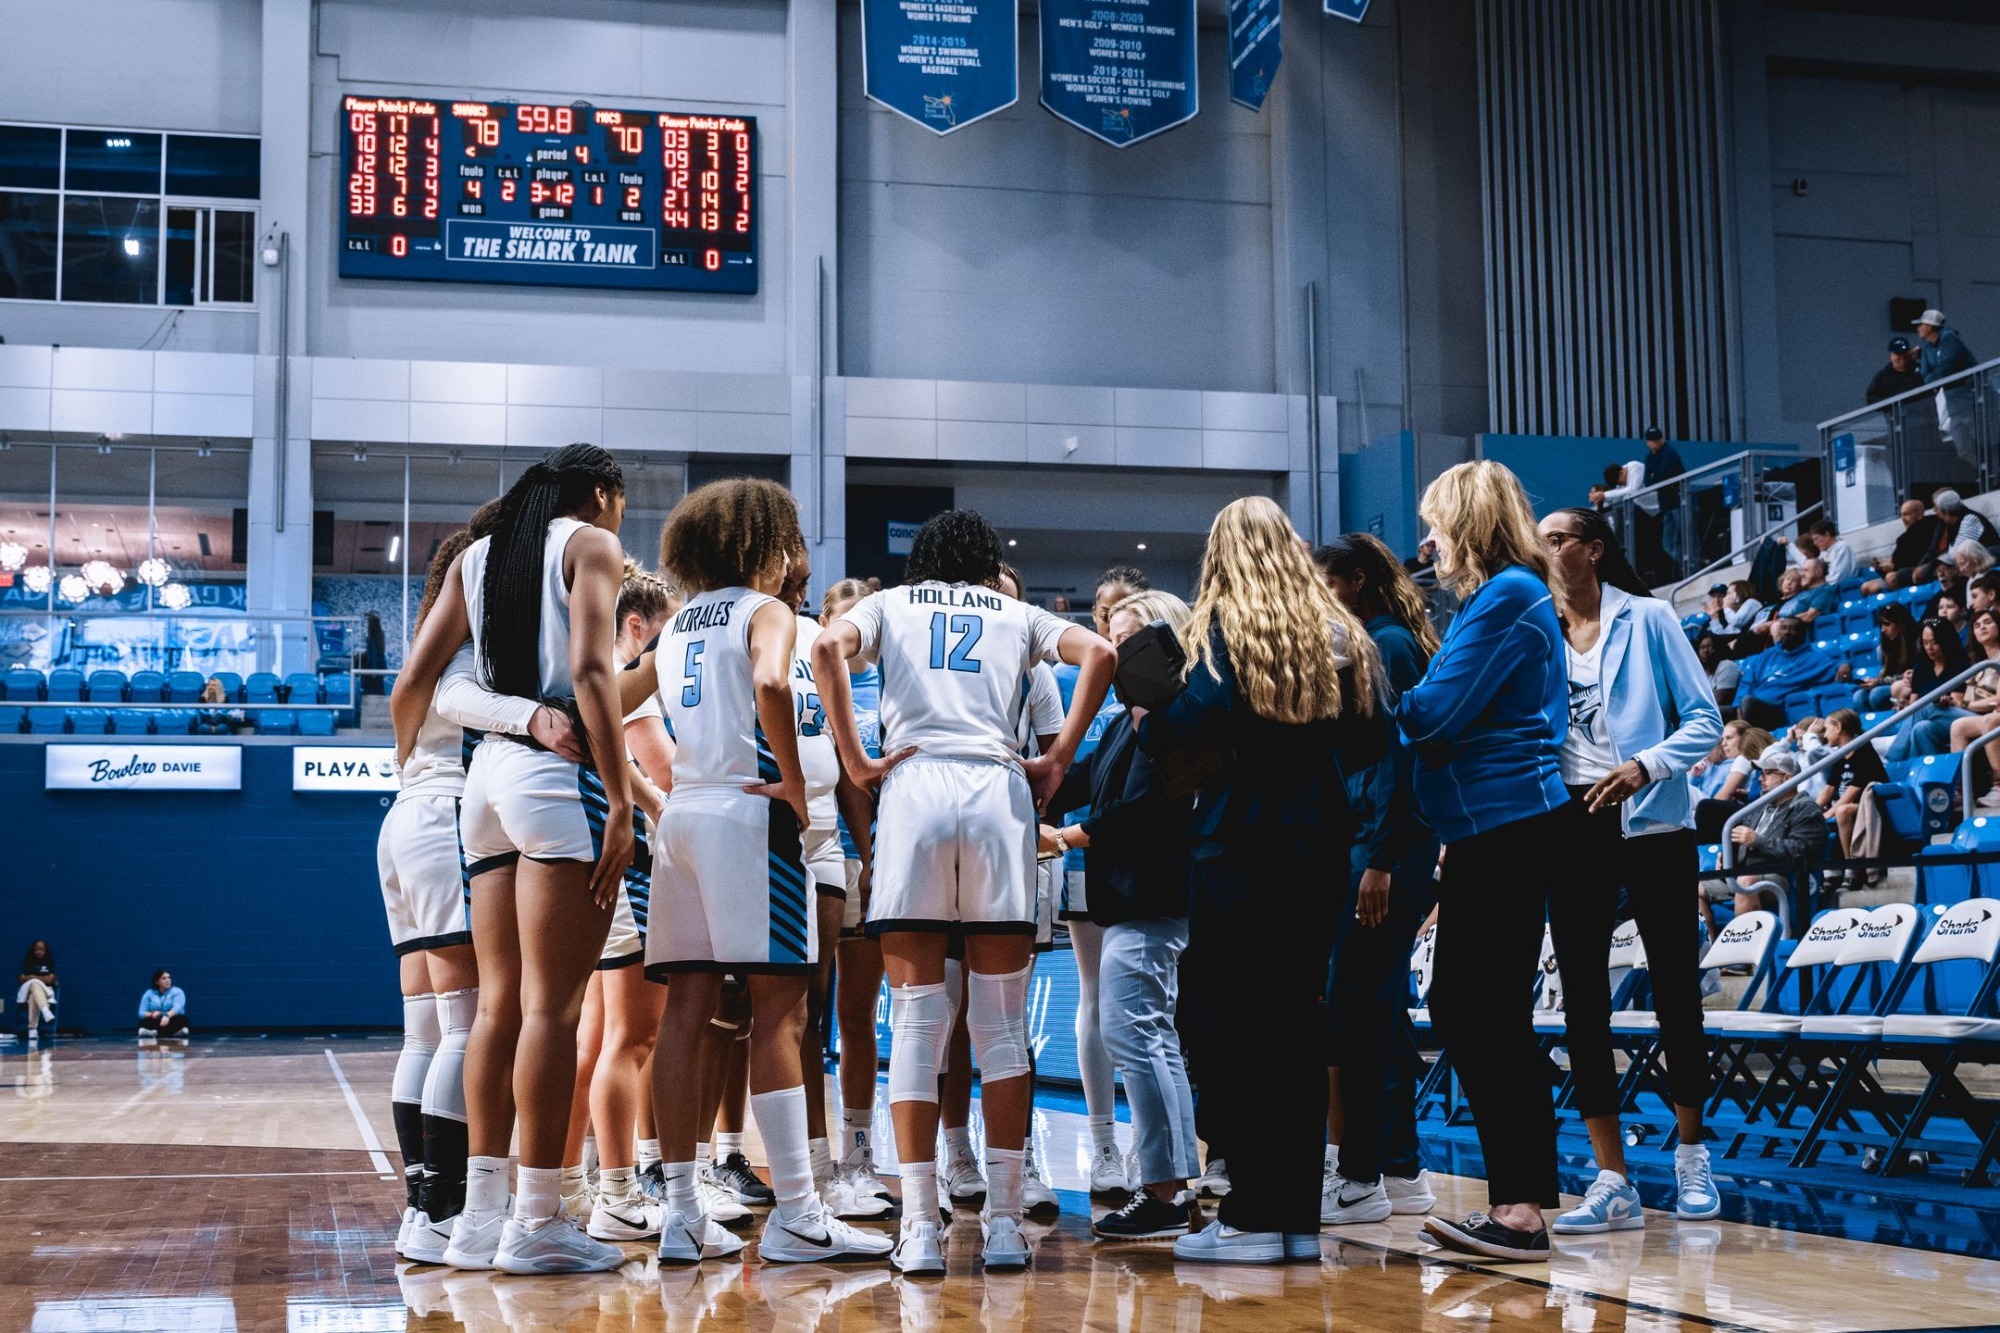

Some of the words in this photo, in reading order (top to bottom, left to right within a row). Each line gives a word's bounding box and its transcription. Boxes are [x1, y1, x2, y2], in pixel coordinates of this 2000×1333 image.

[900, 2, 933, 12] WOMEN'S
[935, 5, 978, 14] BASKETBALL
[1092, 10, 1144, 23] 2008-2009
[906, 12, 940, 22] WOMEN'S
[942, 14, 972, 23] ROWING
[1060, 18, 1082, 28] MEN'S
[1084, 20, 1102, 30] GOLF
[1111, 23, 1144, 33] WOMEN'S
[1146, 26, 1175, 36] ROWING
[912, 35, 966, 47] 2014-2015
[1094, 38, 1142, 50] 2009-2010
[900, 46, 936, 56] WOMEN'S
[938, 48, 978, 58] SWIMMING
[1089, 48, 1125, 58] WOMEN'S
[1126, 51, 1146, 60] GOLF
[898, 55, 934, 64] WOMEN'S
[936, 57, 982, 67] BASKETBALL
[922, 66, 958, 75] BASEBALL
[1093, 65, 1144, 78] 2010-2011
[1050, 73, 1085, 83] WOMEN'S
[1087, 76, 1116, 85] SOCCER
[1122, 78, 1145, 88] MEN'S
[1147, 80, 1186, 90] SWIMMING
[1066, 84, 1100, 94] WOMEN'S
[1102, 86, 1121, 95] GOLF
[1128, 87, 1150, 97] MEN'S
[1152, 90, 1170, 98] GOLF
[378, 101, 408, 114] Points
[409, 102, 436, 114] Fouls
[1086, 94, 1120, 104] WOMEN'S
[1122, 96, 1152, 106] ROWING
[452, 104, 488, 118] SHARKS
[595, 111, 622, 125] MOCS
[351, 112, 376, 133] 05
[390, 115, 408, 134] 17
[432, 117, 438, 136] 1
[517, 106, 572, 134] 59.8
[690, 118, 718, 130] Points
[720, 118, 746, 131] Fouls
[468, 119, 498, 146] 78
[612, 127, 642, 154] 70
[664, 129, 688, 148] 03
[706, 131, 718, 150] 3
[736, 133, 748, 152] 0
[358, 134, 376, 154] 10
[389, 135, 407, 155] 12
[426, 137, 438, 156] 4
[536, 148, 568, 162] period
[575, 146, 588, 164] 4
[664, 150, 688, 168] 09
[706, 152, 718, 170] 7
[736, 153, 748, 172] 3
[358, 154, 376, 174] 12
[389, 156, 406, 175] 12
[426, 157, 438, 177] 3
[460, 164, 484, 177] fouls
[536, 168, 569, 183] player
[620, 172, 643, 184] fouls
[671, 170, 688, 190] 12
[702, 172, 718, 190] 10
[736, 173, 748, 192] 2
[350, 174, 376, 194] 23
[395, 176, 406, 195] 7
[425, 178, 438, 196] 4
[467, 180, 481, 198] 4
[502, 181, 516, 202] 2
[595, 186, 602, 204] 1
[626, 187, 640, 208] 2
[664, 190, 688, 208] 21
[702, 192, 718, 210] 14
[742, 194, 748, 211] 1
[350, 194, 376, 214] 33
[394, 196, 406, 216] 6
[424, 198, 438, 218] 2
[462, 204, 482, 214] won
[539, 207, 564, 218] game
[622, 212, 640, 222] won
[664, 210, 688, 229] 44
[702, 211, 719, 230] 13
[736, 212, 748, 232] 2
[509, 226, 572, 240] WELCOME
[574, 229, 590, 242] TO
[392, 235, 406, 256] 0
[464, 237, 502, 258] THE
[505, 240, 578, 262] SHARK
[583, 243, 638, 264] TANK
[706, 250, 719, 270] 0
[910, 588, 1002, 610] HOLLAND
[672, 601, 734, 636] MORALES
[930, 612, 982, 674] 12
[682, 640, 705, 707] 5
[88, 754, 156, 783] Bowlero
[162, 762, 201, 772] DAVIE
[304, 762, 370, 776] PLAYA
[1809, 927, 1847, 942] Sharks
[1858, 922, 1893, 938] Sharks
[1936, 918, 1978, 936] Sharks
[1721, 928, 1753, 944] Sharks
